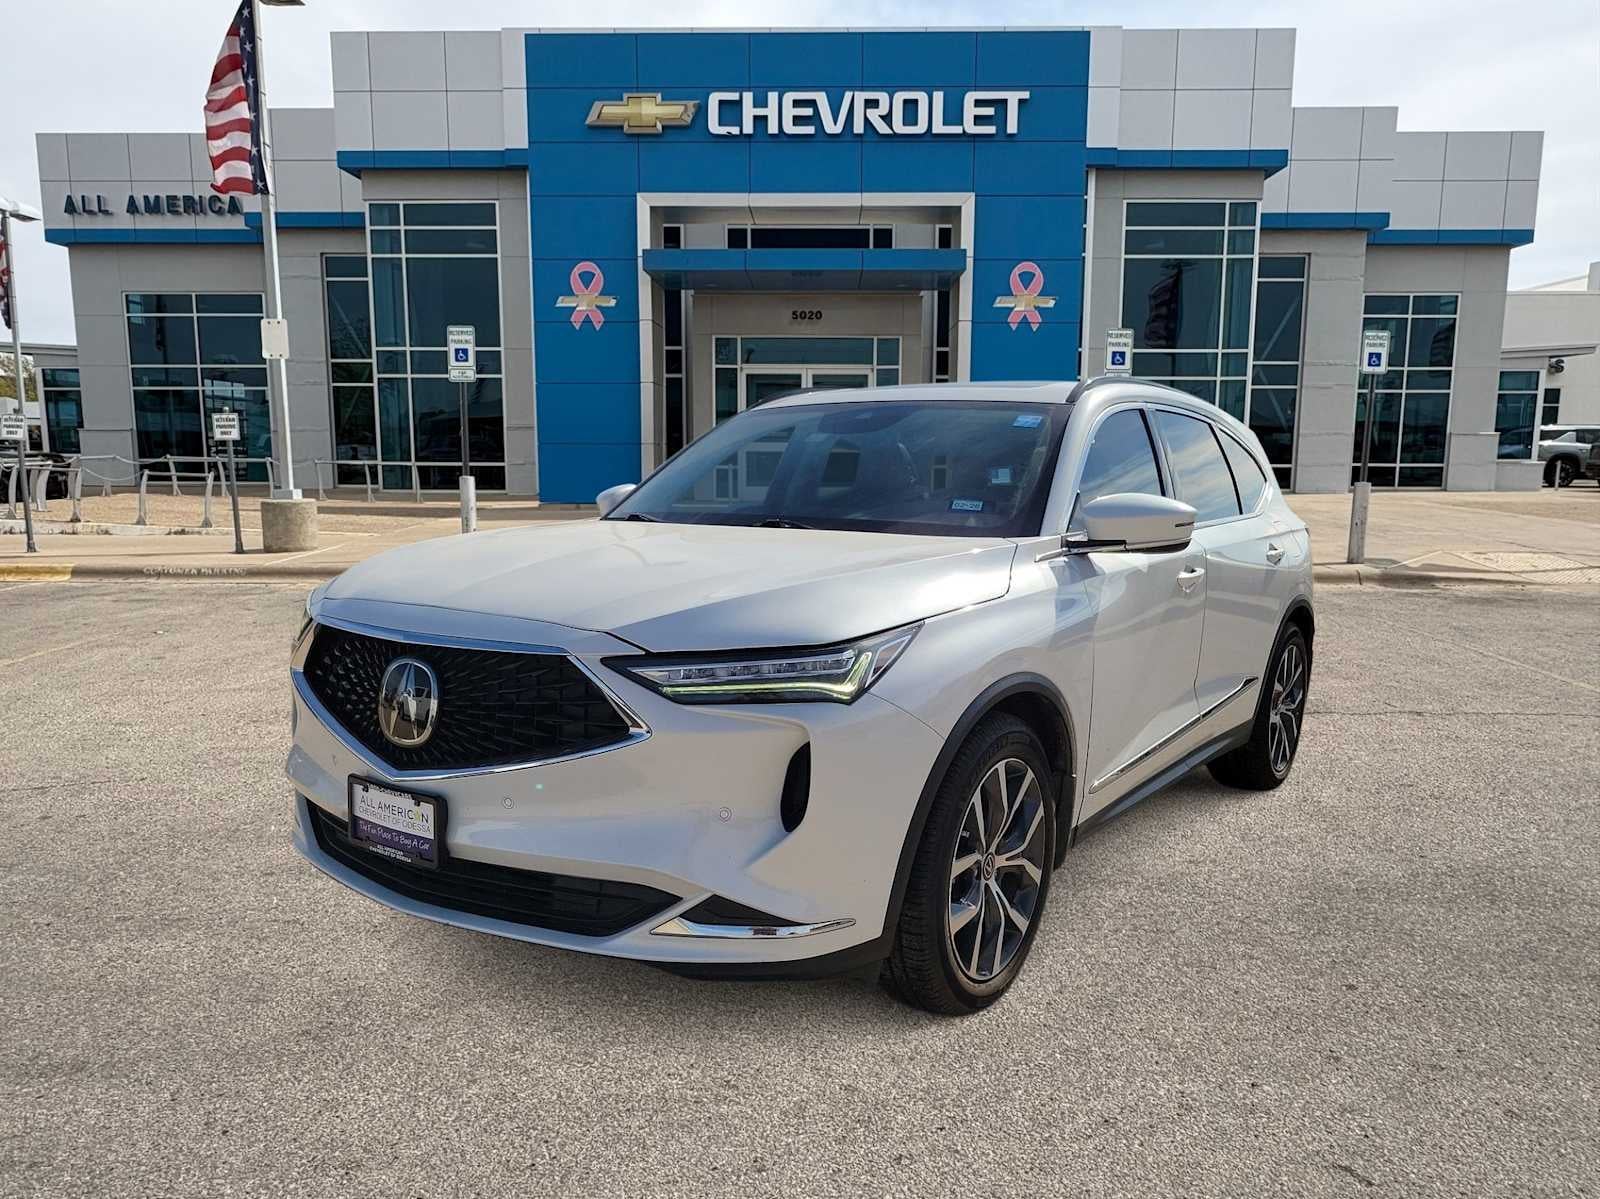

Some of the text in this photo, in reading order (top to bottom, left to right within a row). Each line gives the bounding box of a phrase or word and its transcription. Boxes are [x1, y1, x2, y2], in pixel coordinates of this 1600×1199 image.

[708, 91, 1030, 135] CHEVROLET
[64, 195, 112, 215] ALL
[791, 310, 823, 320] 5020
[359, 806, 431, 833] CHEVROLET OF ODESSA
[360, 795, 429, 823] ALL AMERICAN
[377, 827, 391, 840] Place
[391, 832, 399, 842] To
[399, 835, 411, 848] Buy
[412, 839, 418, 848] A
